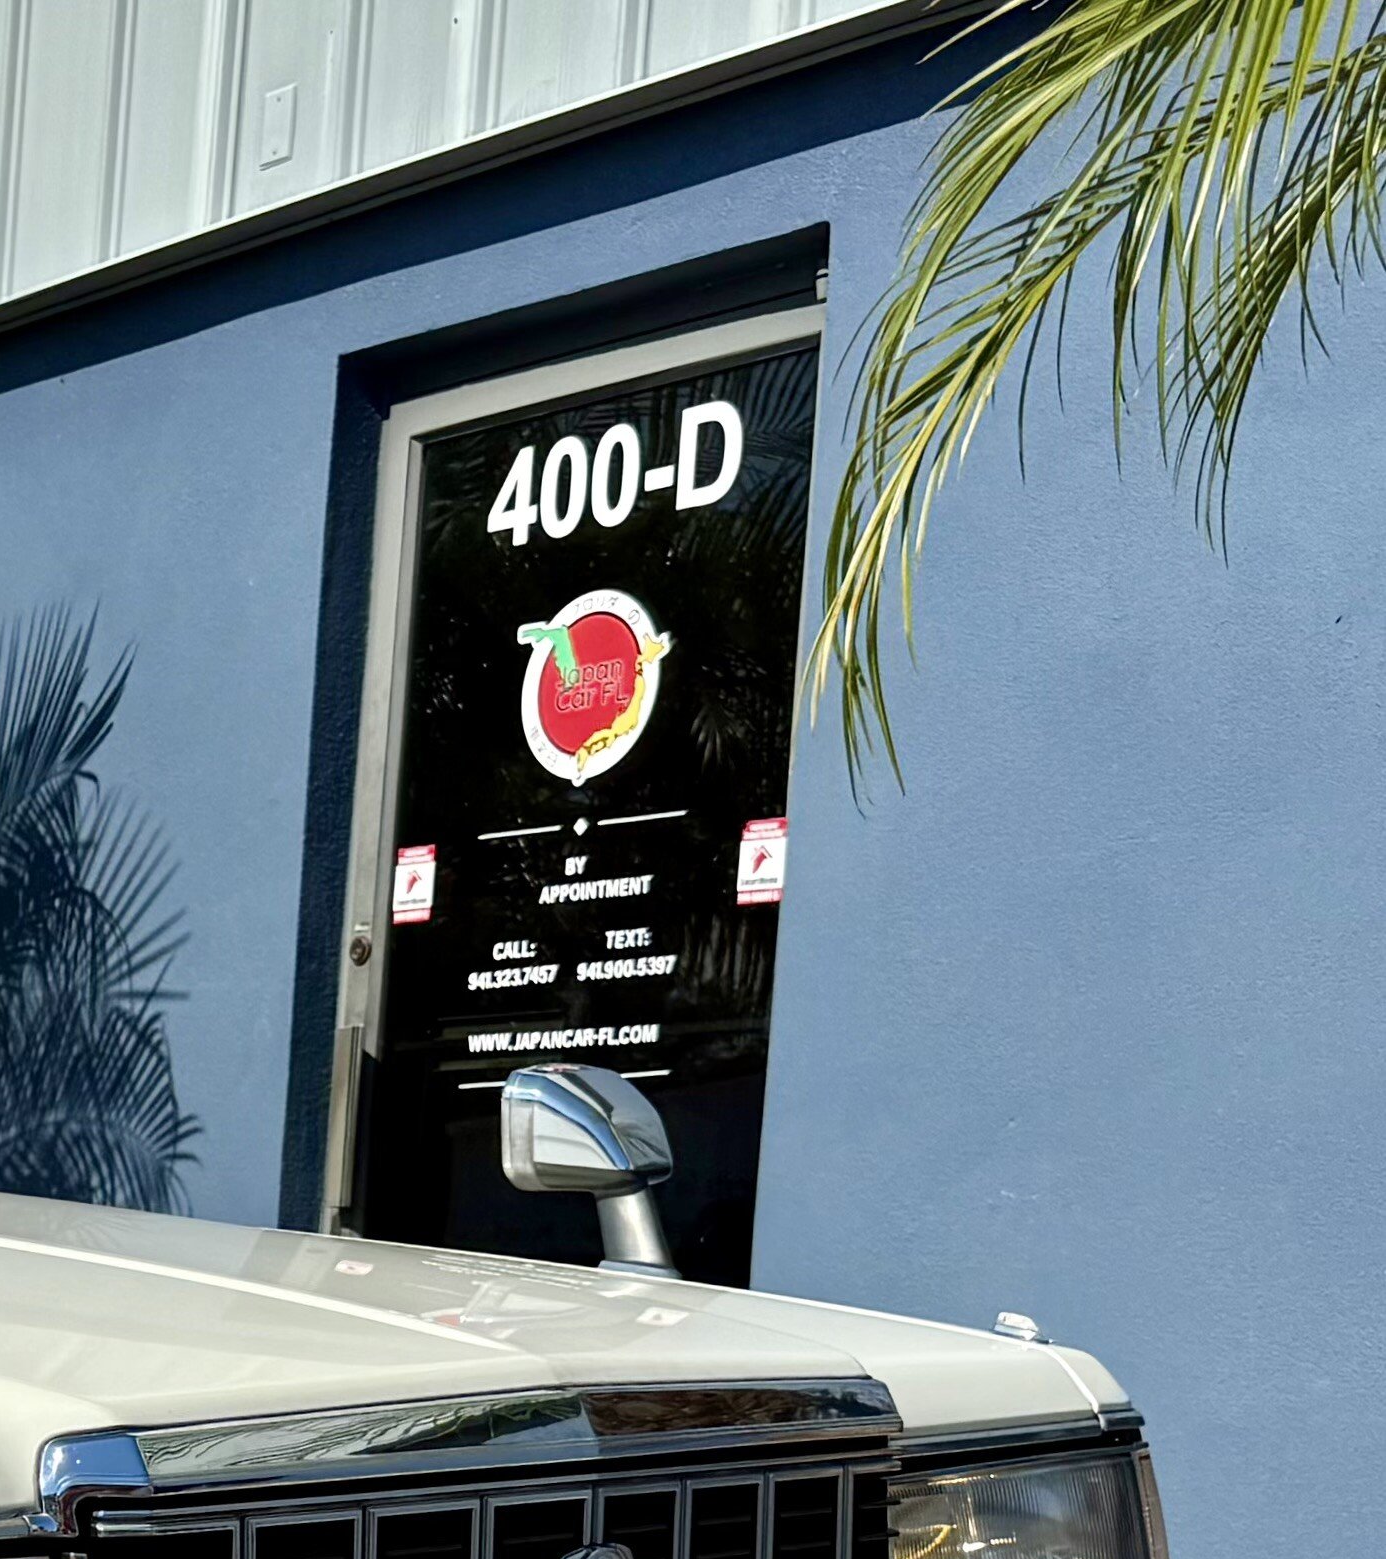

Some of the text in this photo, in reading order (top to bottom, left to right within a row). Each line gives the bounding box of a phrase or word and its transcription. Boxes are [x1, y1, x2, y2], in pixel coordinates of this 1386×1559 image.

[487, 400, 743, 546] 400-D
[558, 660, 623, 690] Japan
[556, 680, 629, 712] Car FL
[565, 856, 588, 876] BY
[539, 874, 654, 904] APPOINTMENT
[493, 940, 538, 960] CALL:
[605, 927, 653, 949] TEXT:
[576, 955, 678, 981] 941.900.5397
[468, 1024, 661, 1052] WWW.JAPANCAR-FL.COM
